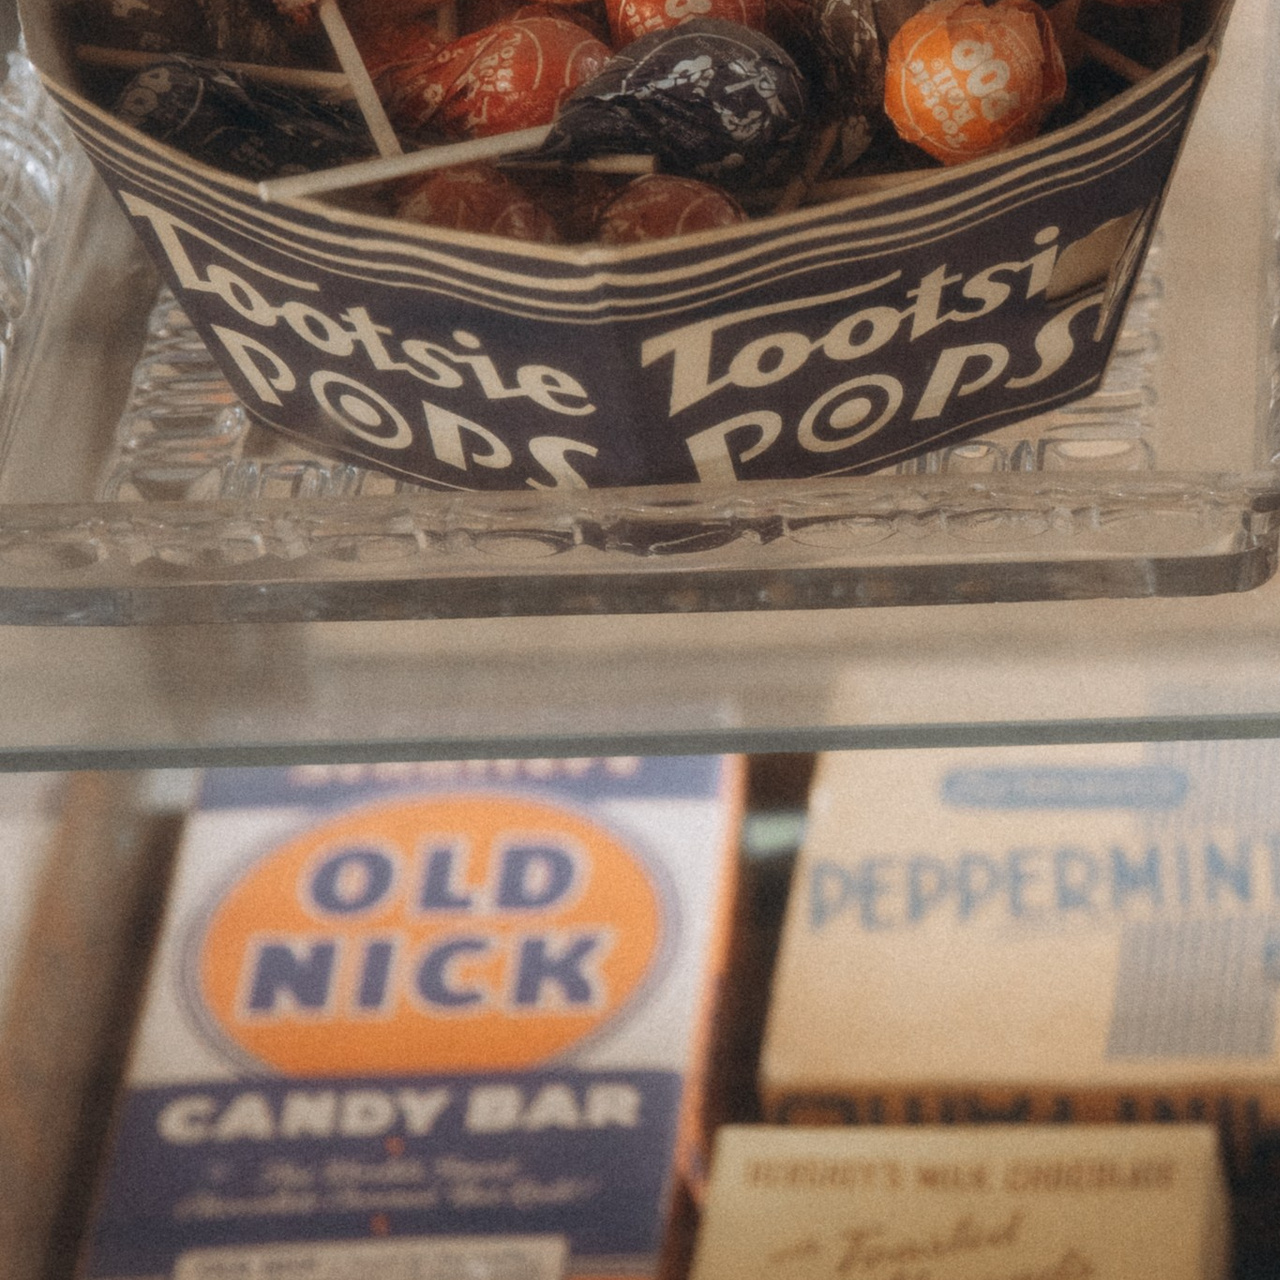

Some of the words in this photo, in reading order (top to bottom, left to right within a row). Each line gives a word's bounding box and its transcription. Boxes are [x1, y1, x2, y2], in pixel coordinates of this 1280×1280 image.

[117, 189, 598, 417] Tootsie
[641, 225, 1060, 418] Tootsi
[309, 844, 577, 915] OLD
[245, 934, 599, 1015] NICK
[155, 1087, 452, 1144] CANDY
[464, 1081, 643, 1133] BAR
